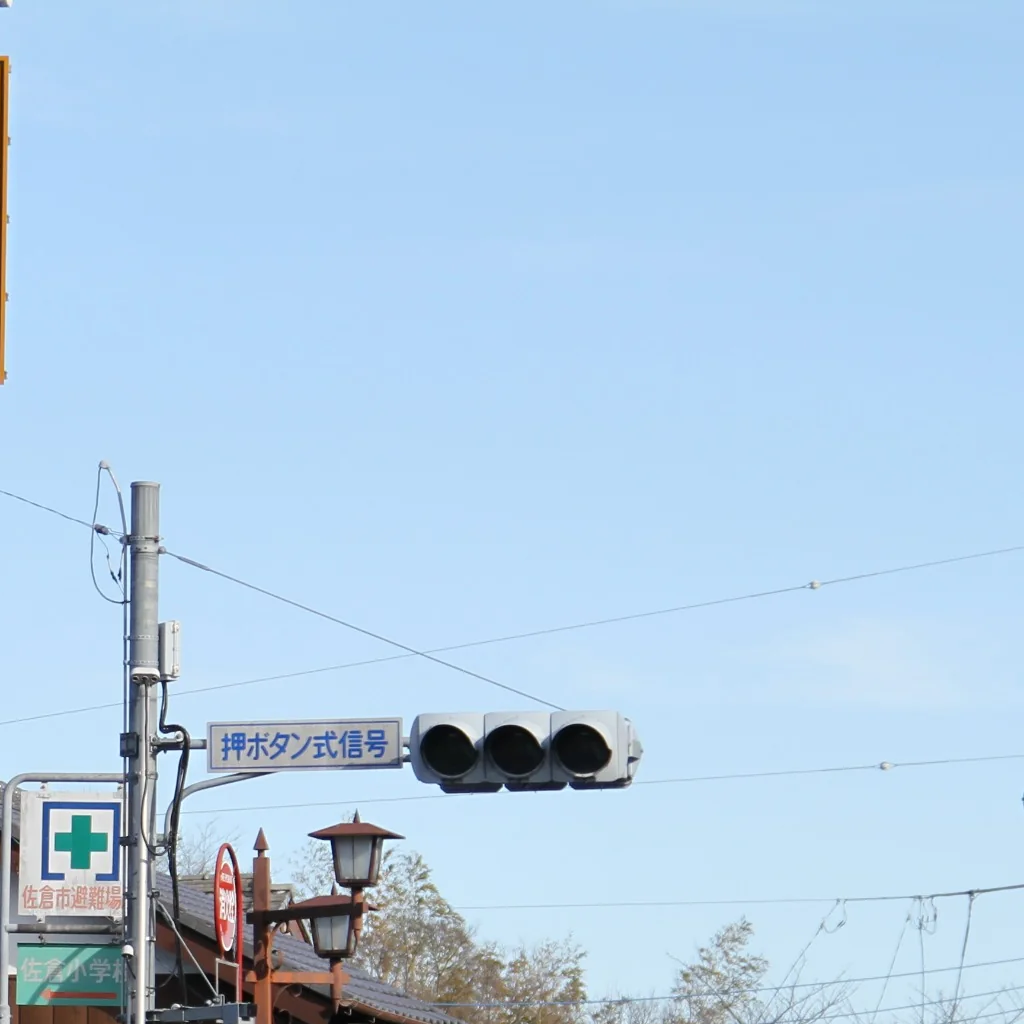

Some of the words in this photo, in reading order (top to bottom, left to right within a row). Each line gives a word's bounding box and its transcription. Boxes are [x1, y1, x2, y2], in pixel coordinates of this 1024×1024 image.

[221, 729, 389, 761] 押ボタン式信号
[22, 884, 125, 911] 佐倉市避難場
